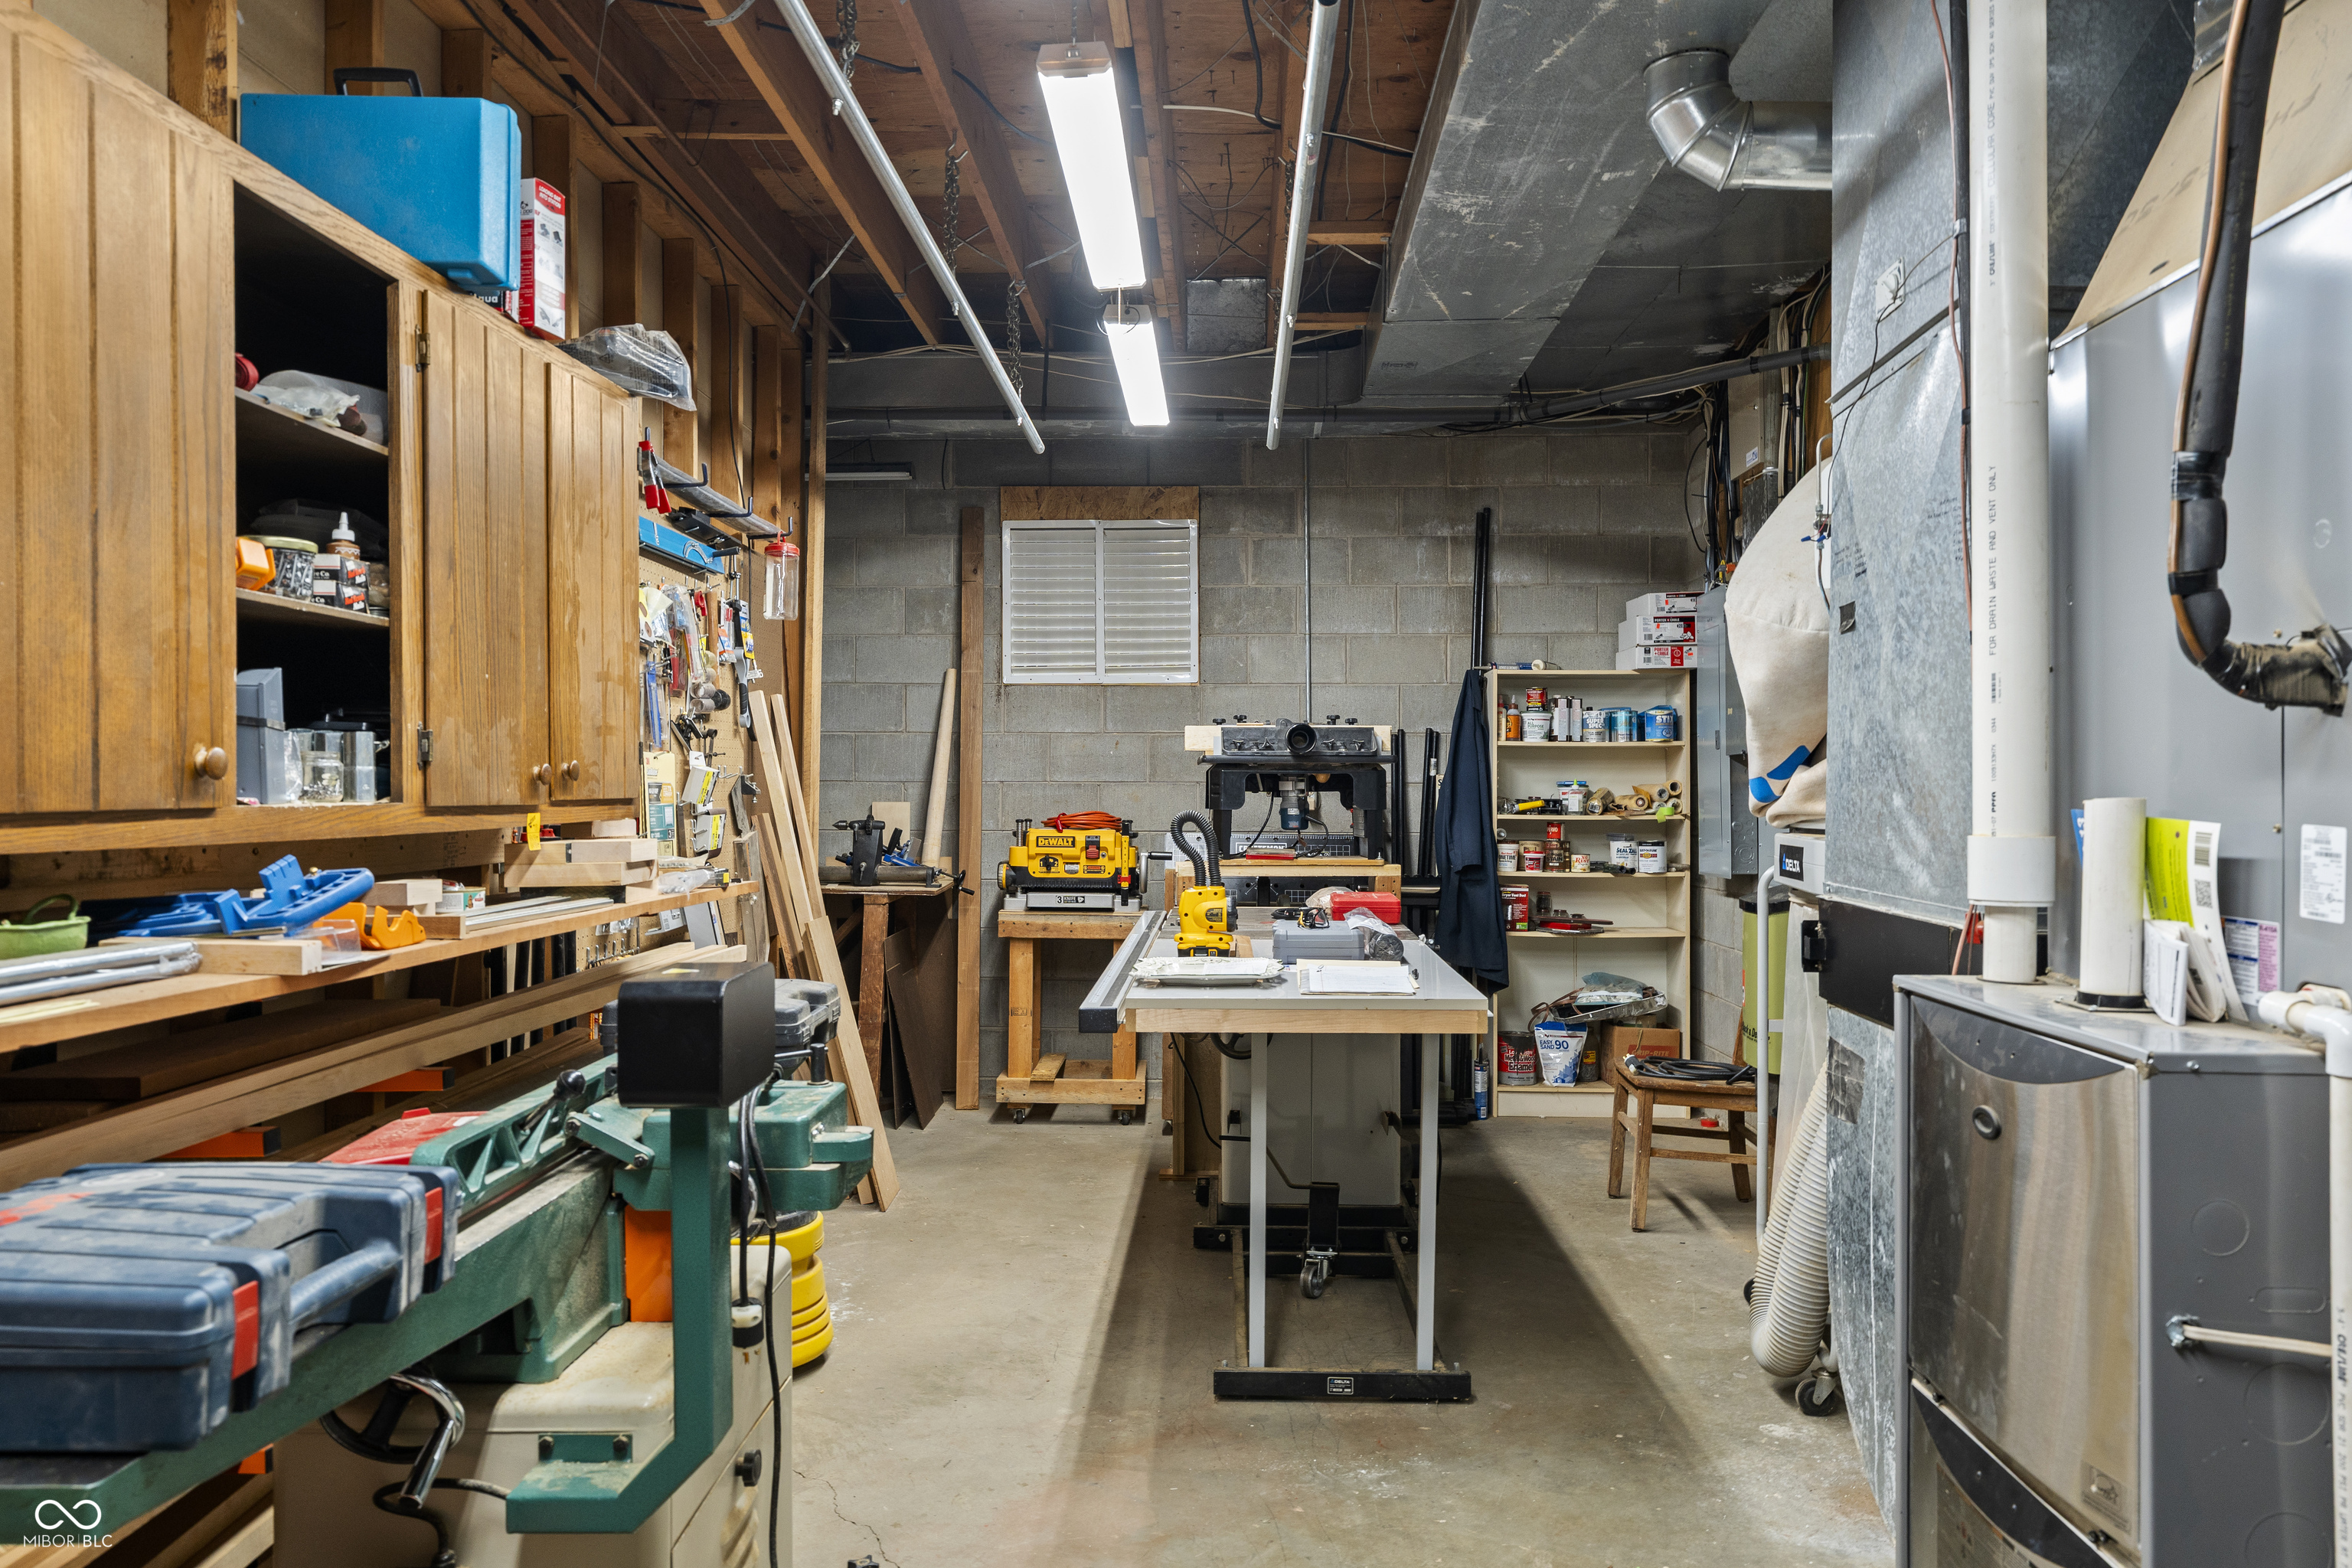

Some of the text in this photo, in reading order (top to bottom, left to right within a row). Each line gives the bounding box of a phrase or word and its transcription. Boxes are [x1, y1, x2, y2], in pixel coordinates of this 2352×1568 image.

[1987, 102, 1995, 129] CORE
[1987, 134, 1995, 188] CELLULAR
[1988, 466, 1997, 656] FOR DRAIN WASTE AND VENT ONLY
[1785, 858, 1800, 873] DELTA
[1555, 1040, 1569, 1049] 90
